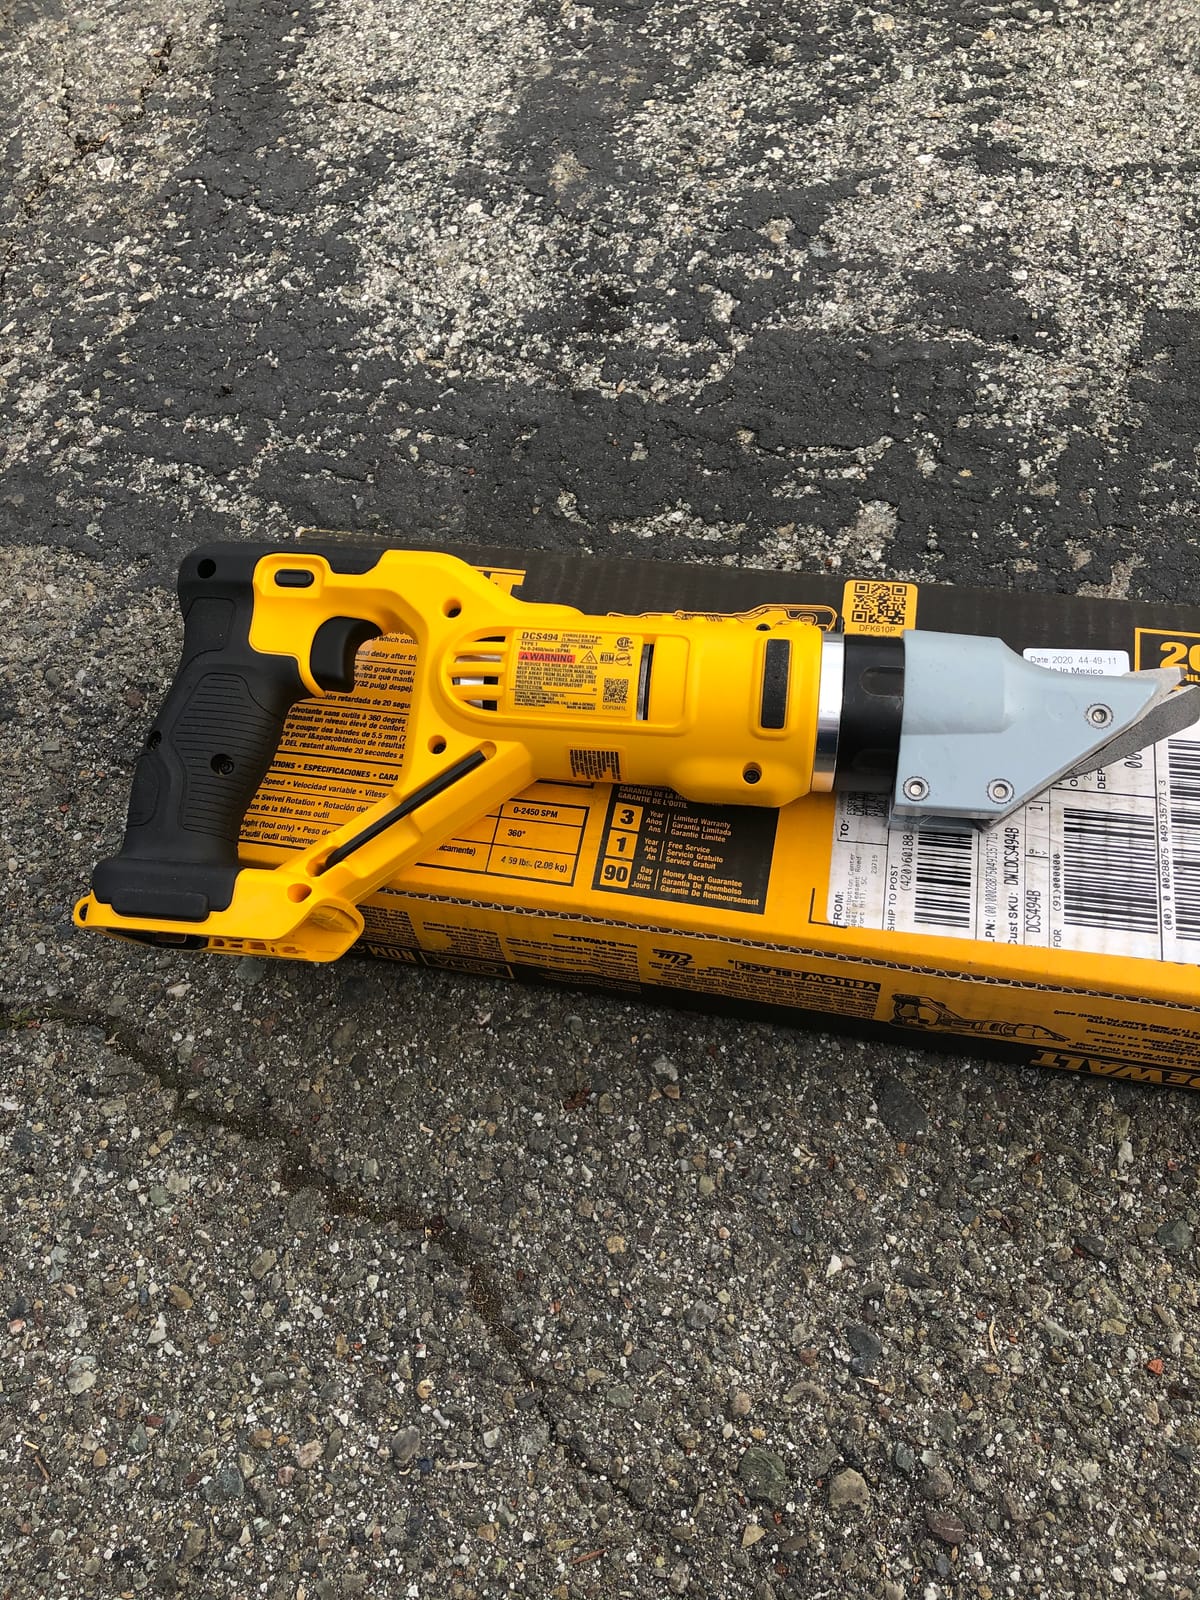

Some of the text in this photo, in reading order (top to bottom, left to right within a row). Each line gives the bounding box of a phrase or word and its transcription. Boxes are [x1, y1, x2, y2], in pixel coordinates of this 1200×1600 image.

[522, 632, 558, 640] DCS494
[859, 624, 896, 634] DFK610P
[371, 650, 388, 659] delay
[531, 652, 573, 663] WARNING
[601, 653, 614, 662] NOM
[1052, 656, 1072, 664] 2020
[325, 718, 347, 726] niveau
[379, 723, 406, 732] confort.
[341, 712, 360, 720] outils
[383, 716, 406, 725] degrés
[291, 731, 307, 739] pour
[296, 724, 320, 732] couper
[335, 728, 359, 736] bandes
[299, 742, 324, 750] restant
[325, 744, 352, 753] allumée
[364, 749, 398, 758] secondes
[303, 764, 370, 778] ESPECIFICACIONES
[263, 777, 285, 786] Speed
[293, 781, 327, 790] Velocidad
[328, 785, 357, 794] variable
[261, 794, 285, 803] Swivel
[286, 796, 316, 806] Rotation
[324, 801, 355, 811] Rotación
[618, 792, 650, 803] GARANTIE
[663, 798, 688, 809] L'OUTIL
[295, 809, 311, 817] sans
[313, 811, 330, 819] outil
[513, 806, 558, 818] 0-2450 SPM
[620, 809, 635, 825] 3
[650, 810, 664, 819] Year
[1159, 792, 1170, 842] 049135771
[260, 821, 276, 829] (tool
[277, 824, 295, 832] only)
[303, 826, 320, 835] Peso
[648, 825, 661, 833] Ans
[673, 814, 731, 830] Limited Warranty
[839, 819, 850, 837] TO:
[262, 832, 279, 840] (outil
[507, 829, 526, 838] 360°
[671, 828, 699, 839] Garantie
[703, 826, 732, 836] Limitada
[616, 837, 627, 852] 1
[644, 838, 659, 846] Year
[668, 841, 711, 854] Free Service
[667, 849, 724, 863] Servicio Gratuito
[900, 834, 914, 892] (420)60188
[555, 863, 567, 873] kg)
[640, 866, 654, 875] Day
[665, 857, 716, 870] Service Gratuit
[1162, 847, 1171, 889] 0028875
[604, 865, 628, 882] 90
[663, 869, 743, 888] Money Back Guarantee
[862, 876, 867, 885] SC
[632, 881, 651, 890] Jours
[693, 881, 702, 889] De
[704, 883, 742, 896] Reembolso
[1004, 827, 1019, 944] Cust SKU: DWLDCS494B
[660, 886, 760, 906] Garantie De Remboursement
[887, 864, 898, 932] SHIP TO POST
[833, 891, 845, 927] FROM:
[1026, 889, 1041, 933] DCS494B
[1163, 908, 1173, 931] (00)
[1053, 929, 1062, 948] FOR
[369, 945, 417, 961] NOM
[737, 962, 793, 977] BLACK
[806, 974, 876, 990] YELLOW
